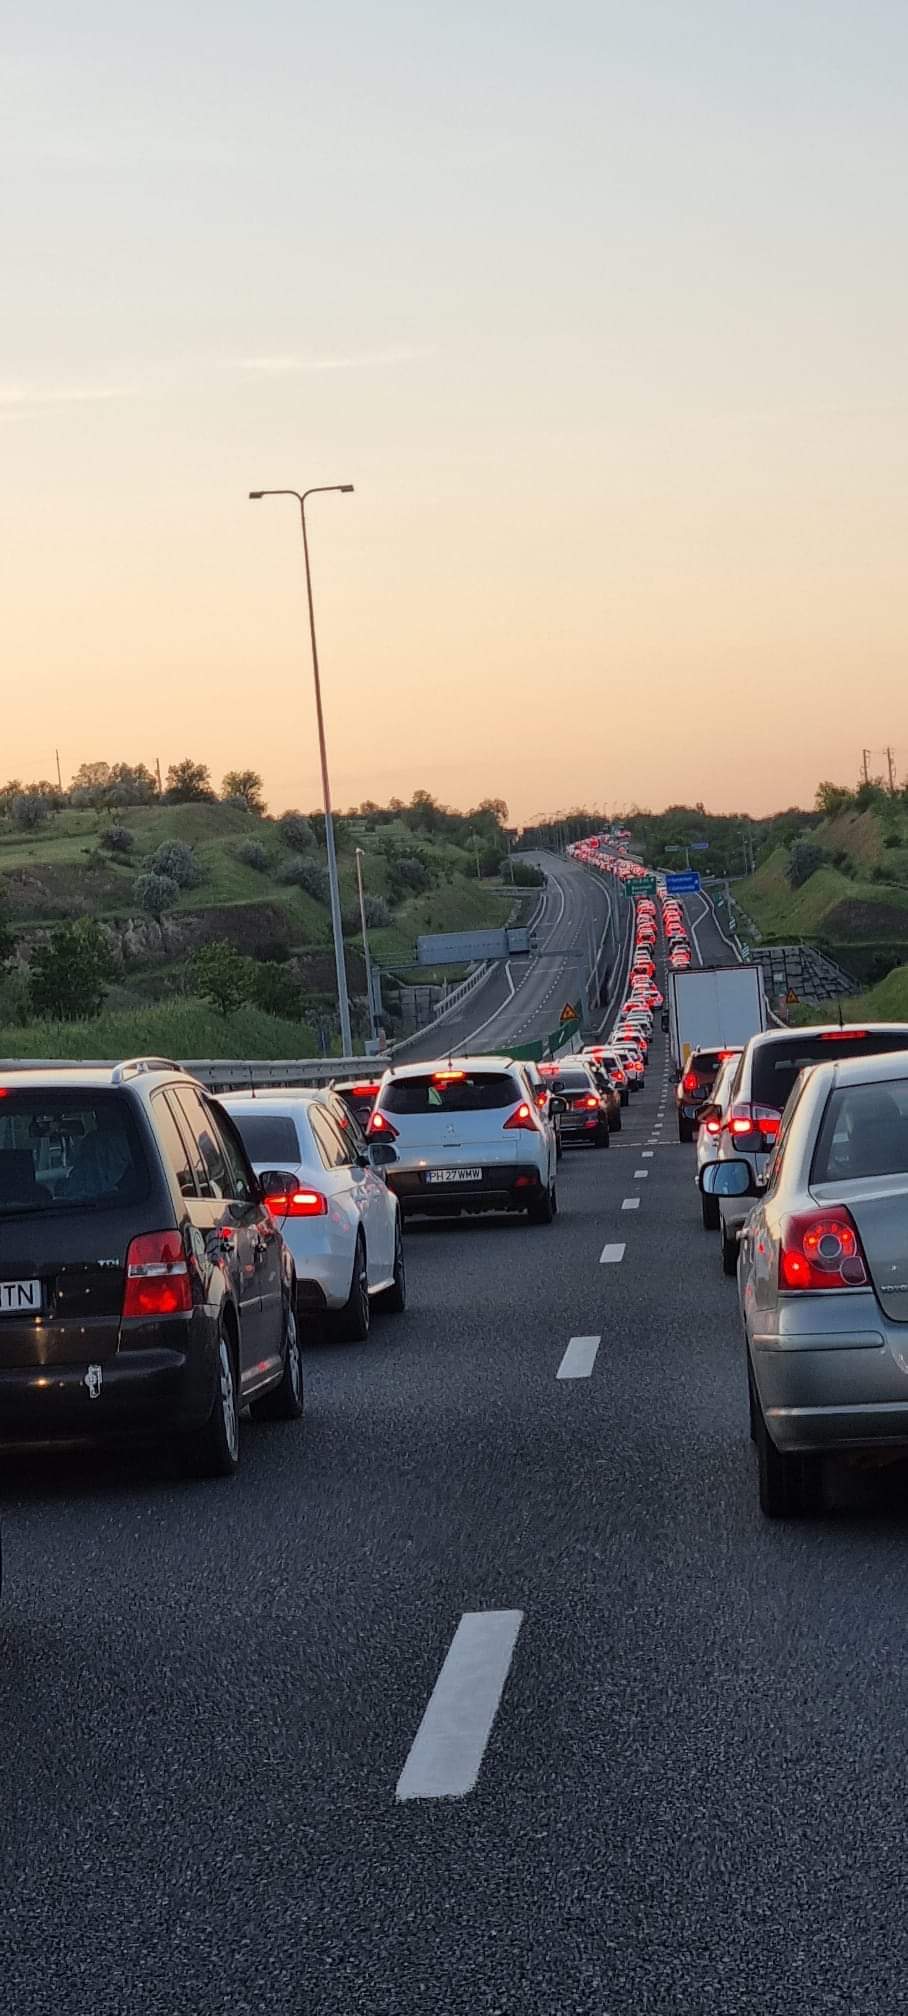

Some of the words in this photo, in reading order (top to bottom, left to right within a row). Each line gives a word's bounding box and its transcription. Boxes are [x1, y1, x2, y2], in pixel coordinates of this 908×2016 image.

[430, 1170, 443, 1182] PH
[444, 1169, 457, 1181] 27
[458, 1168, 480, 1180] WMW
[0, 1283, 34, 1308] TN
